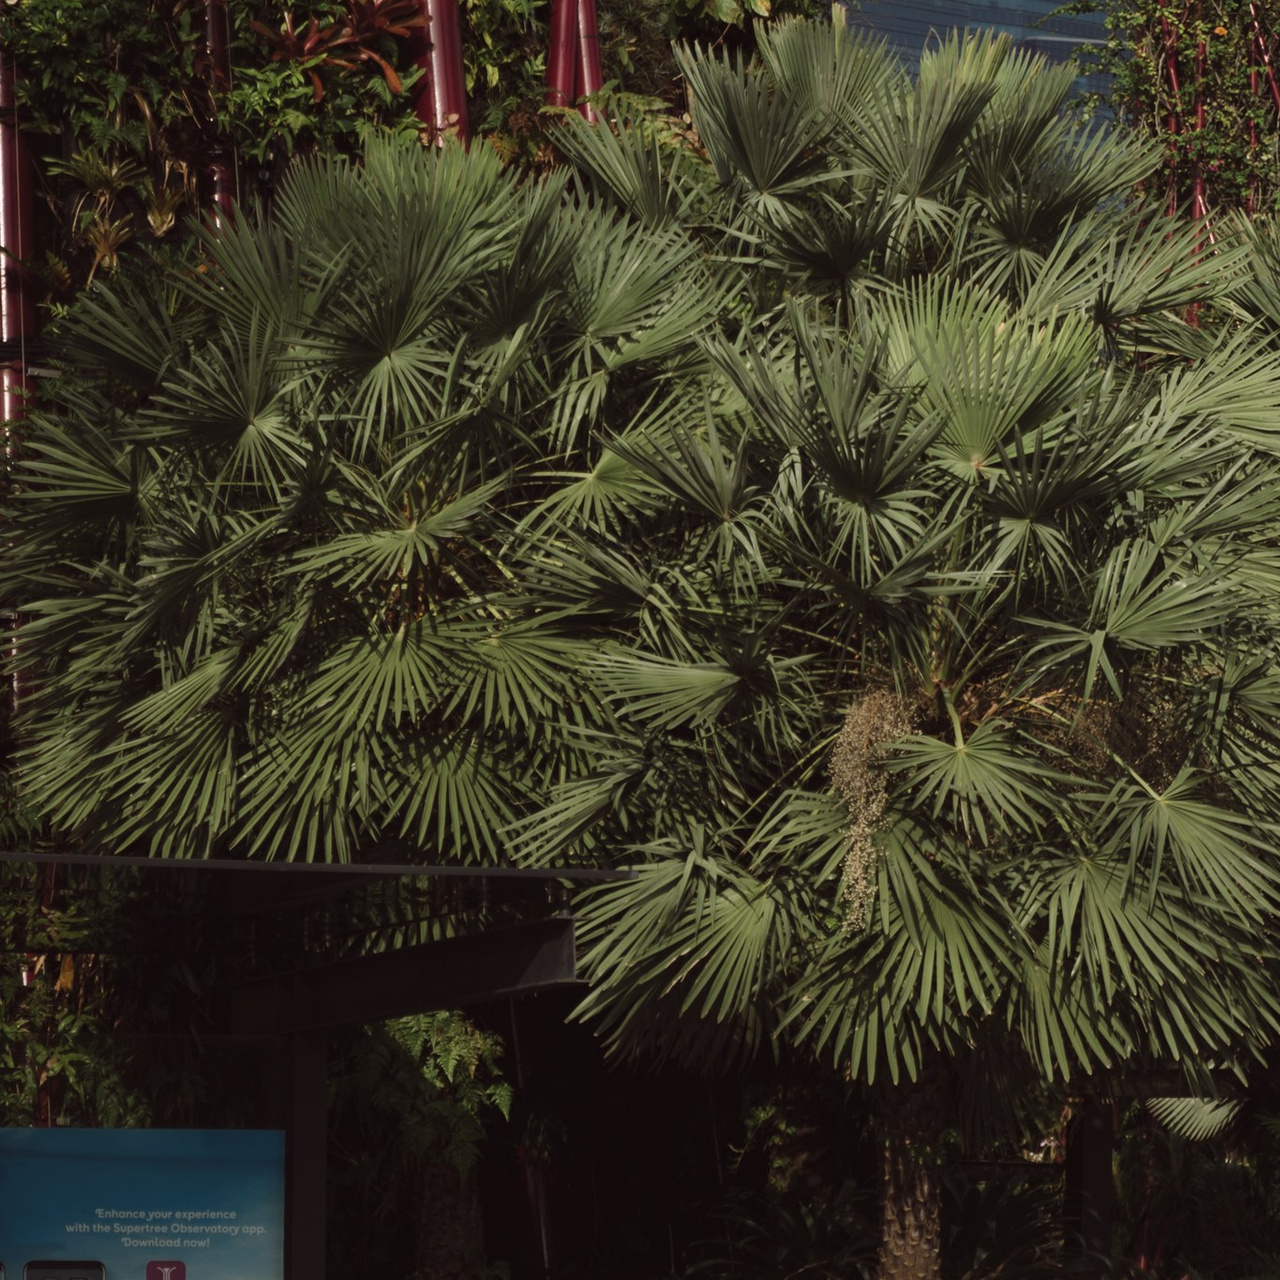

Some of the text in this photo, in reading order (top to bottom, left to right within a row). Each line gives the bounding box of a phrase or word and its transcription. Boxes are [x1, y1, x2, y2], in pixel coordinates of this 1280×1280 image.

[95, 1208, 236, 1222] Enhance your experience
[66, 1223, 267, 1236] with the Supertree Observatory app.
[121, 1237, 210, 1248] Download now!
